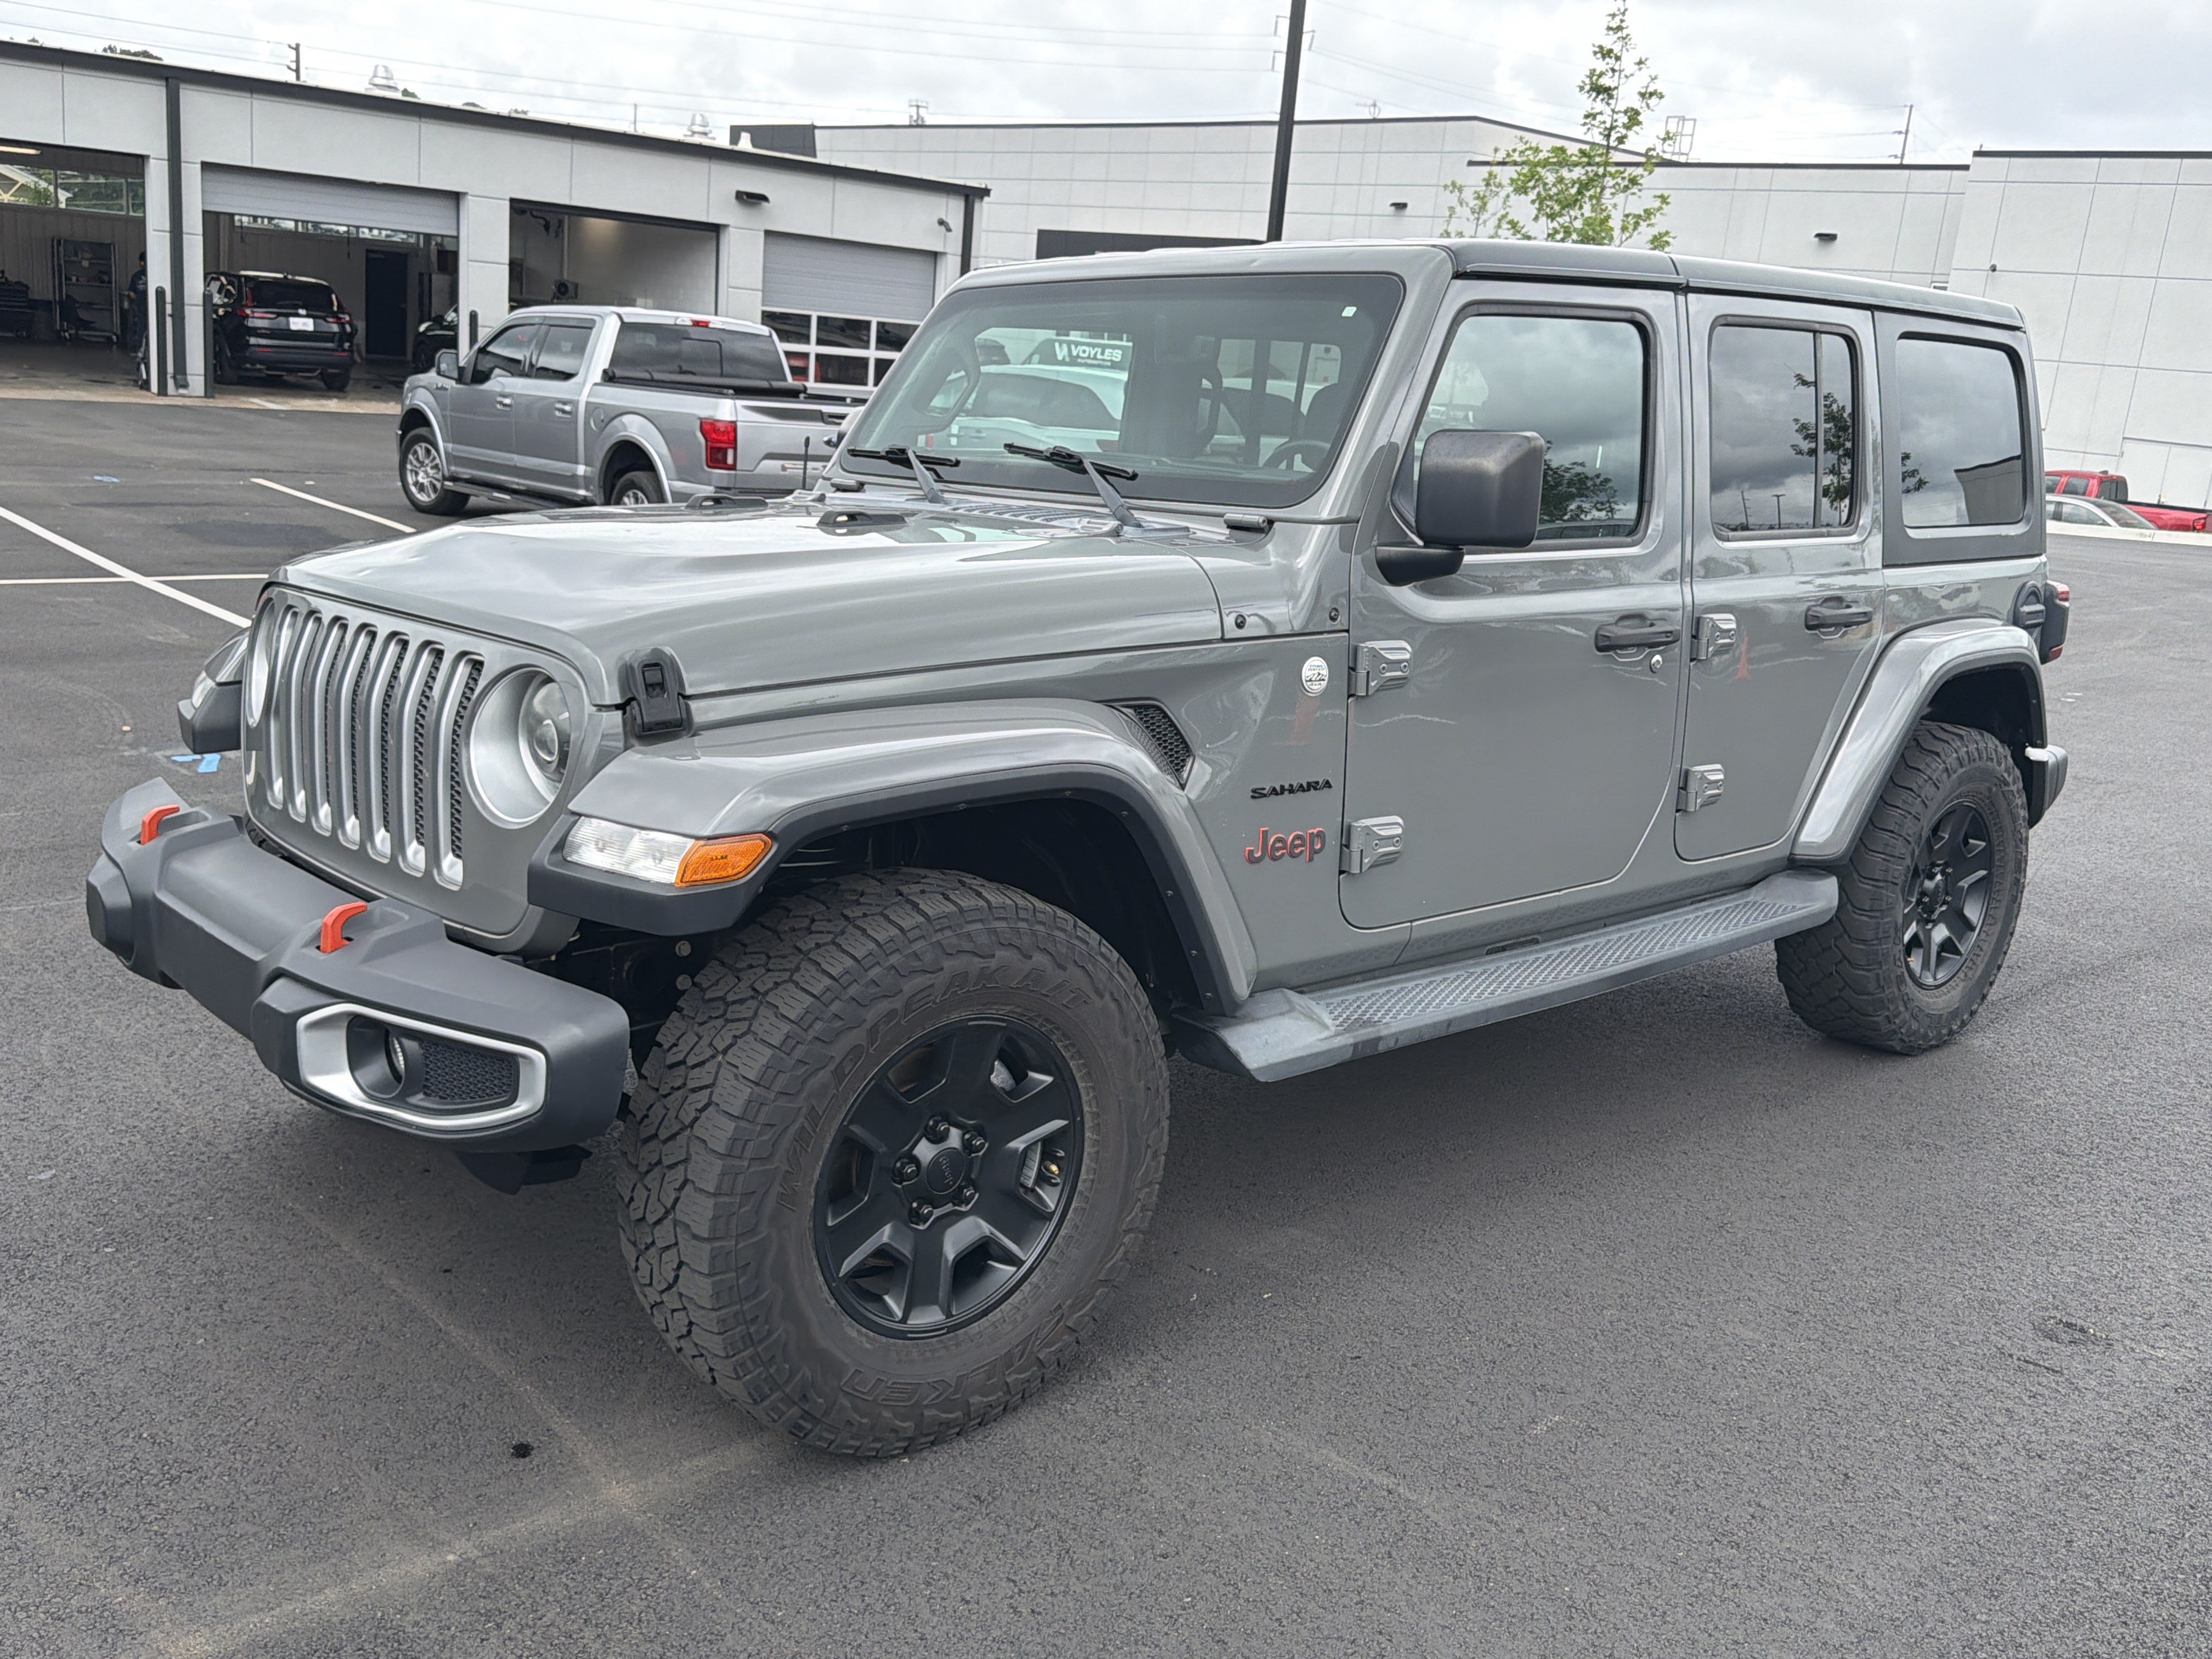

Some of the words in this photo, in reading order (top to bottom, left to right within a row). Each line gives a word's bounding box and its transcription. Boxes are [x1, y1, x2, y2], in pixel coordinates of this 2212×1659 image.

[1070, 344, 1122, 362] VOYLES
[1250, 778, 1333, 799] SAHARA
[1244, 827, 1327, 864] Jeep
